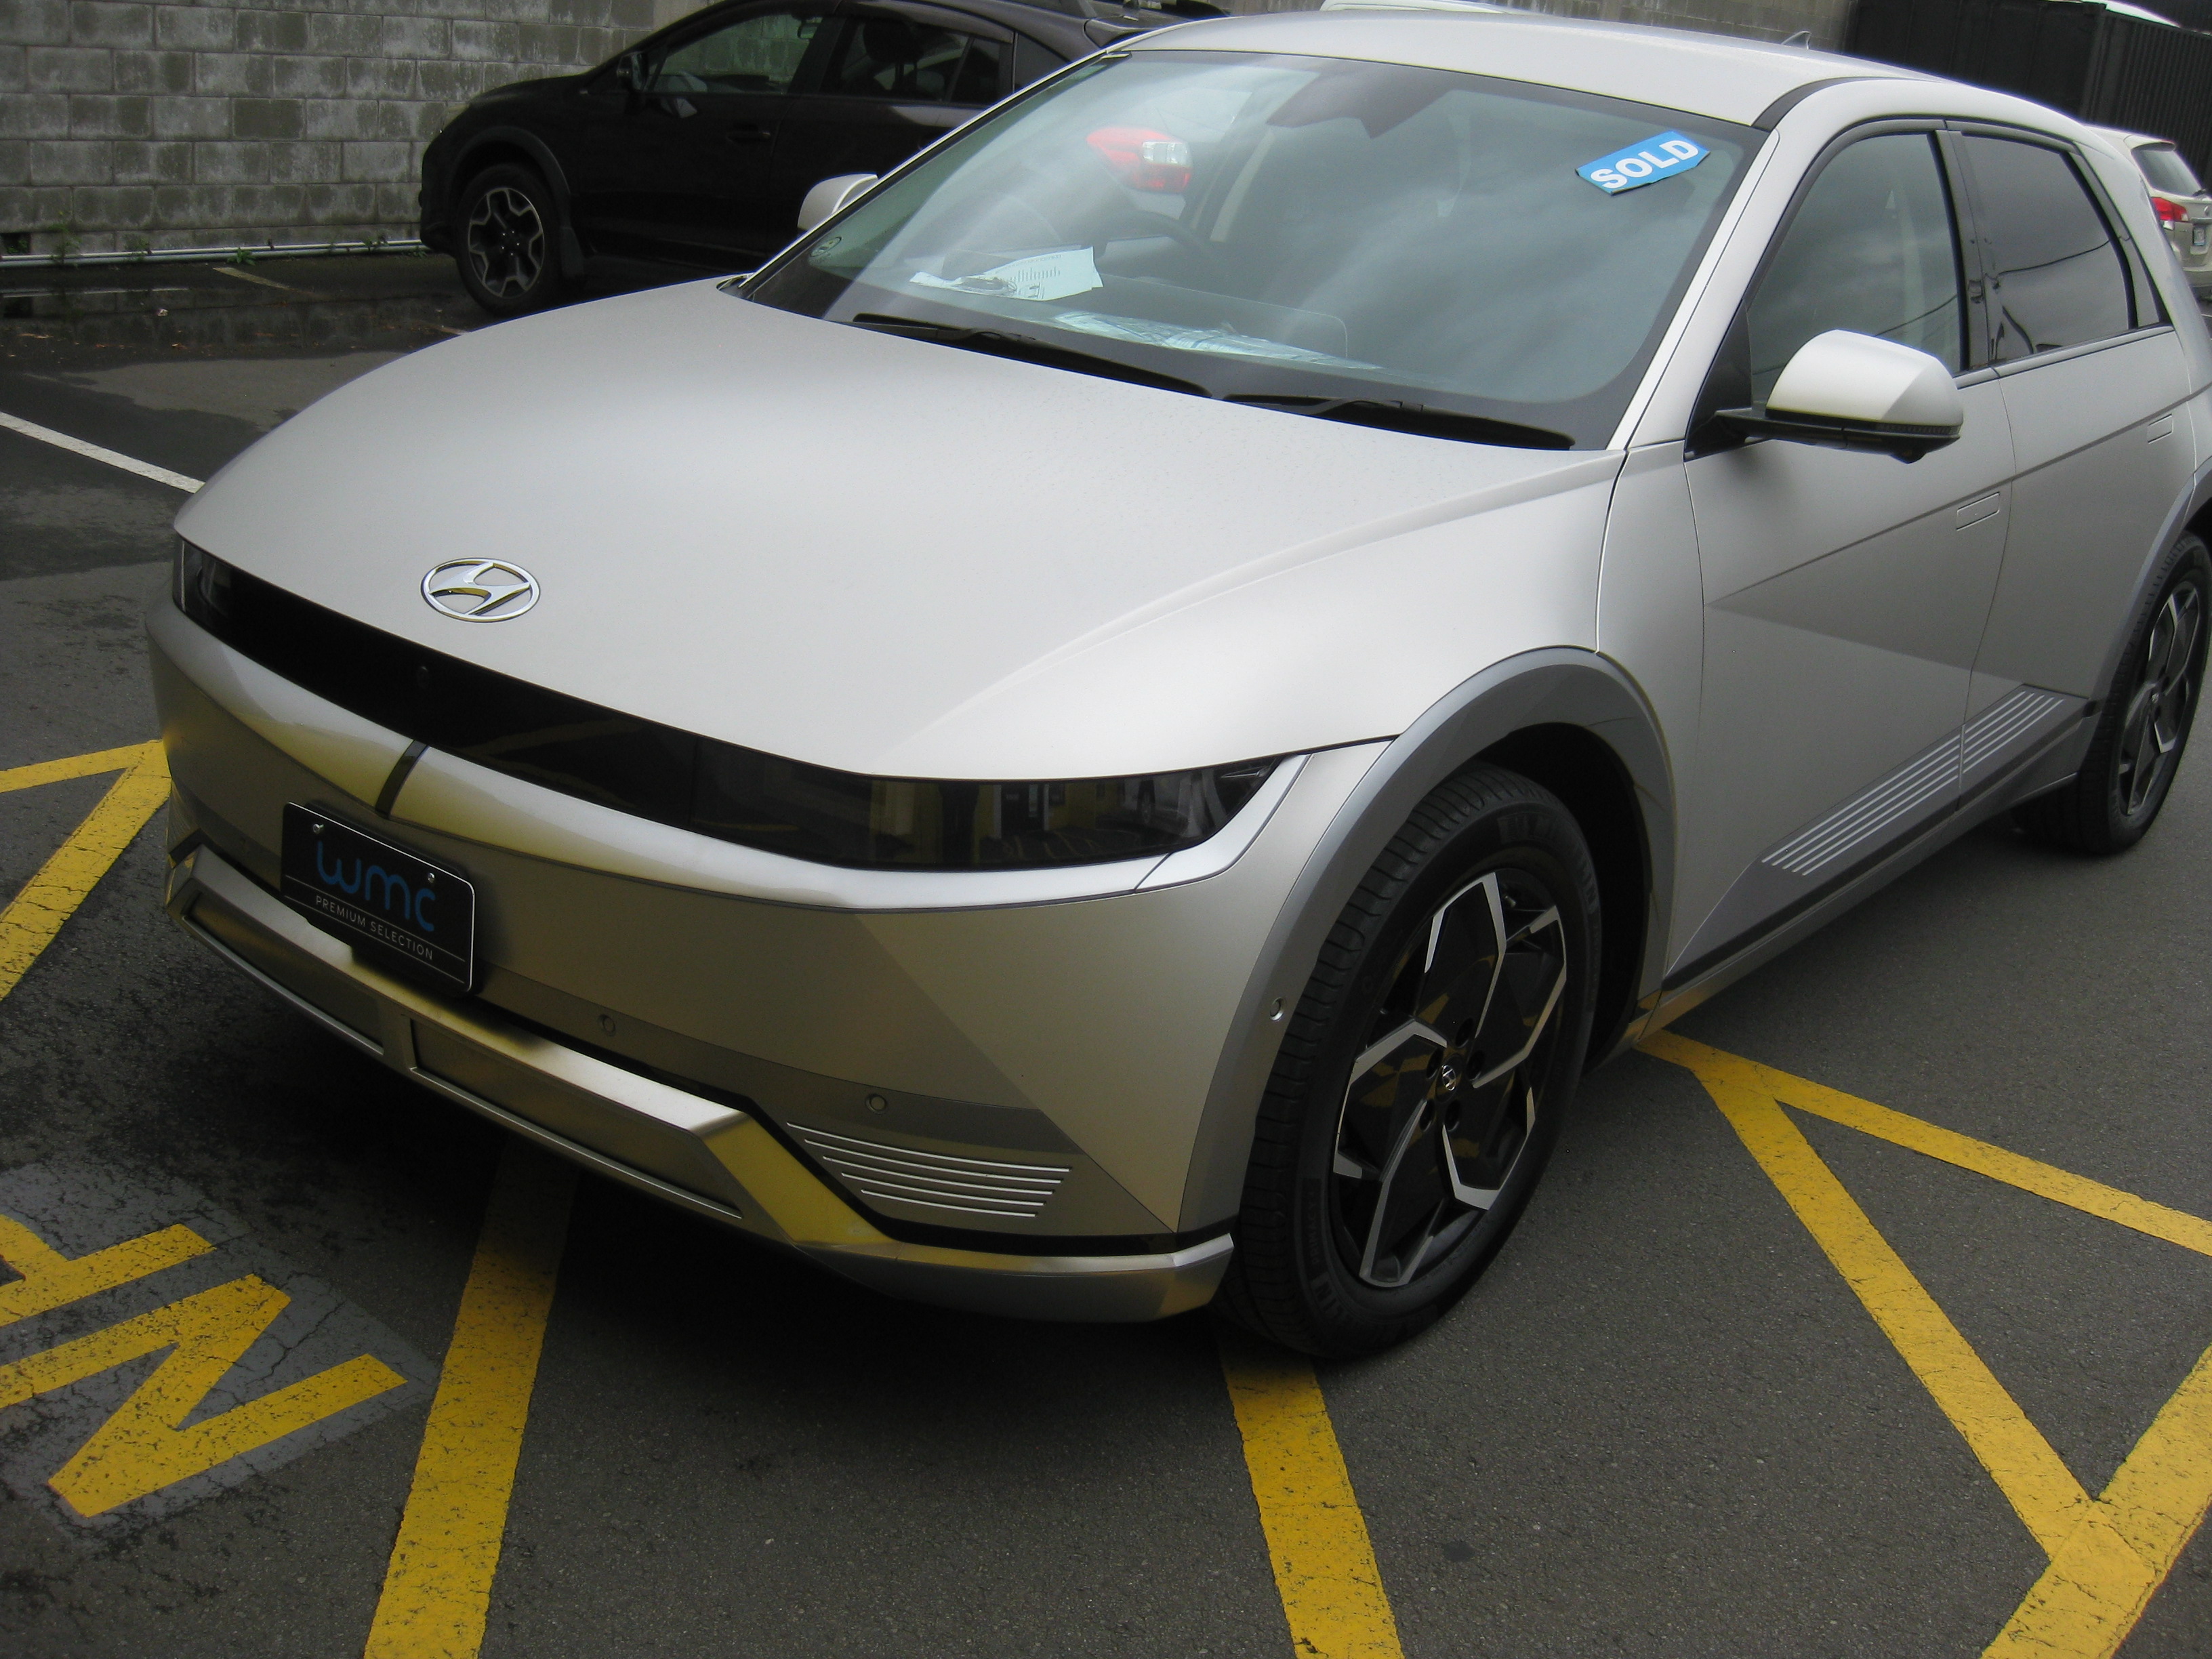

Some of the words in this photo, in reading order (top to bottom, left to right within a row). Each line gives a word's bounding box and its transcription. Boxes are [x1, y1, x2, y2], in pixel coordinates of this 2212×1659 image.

[1590, 140, 1699, 189] SOLD
[316, 840, 436, 932] wmc
[316, 895, 366, 926] PREMIUM
[370, 921, 433, 960] SELECTION
[1307, 1200, 1321, 1265] PRIMACY
